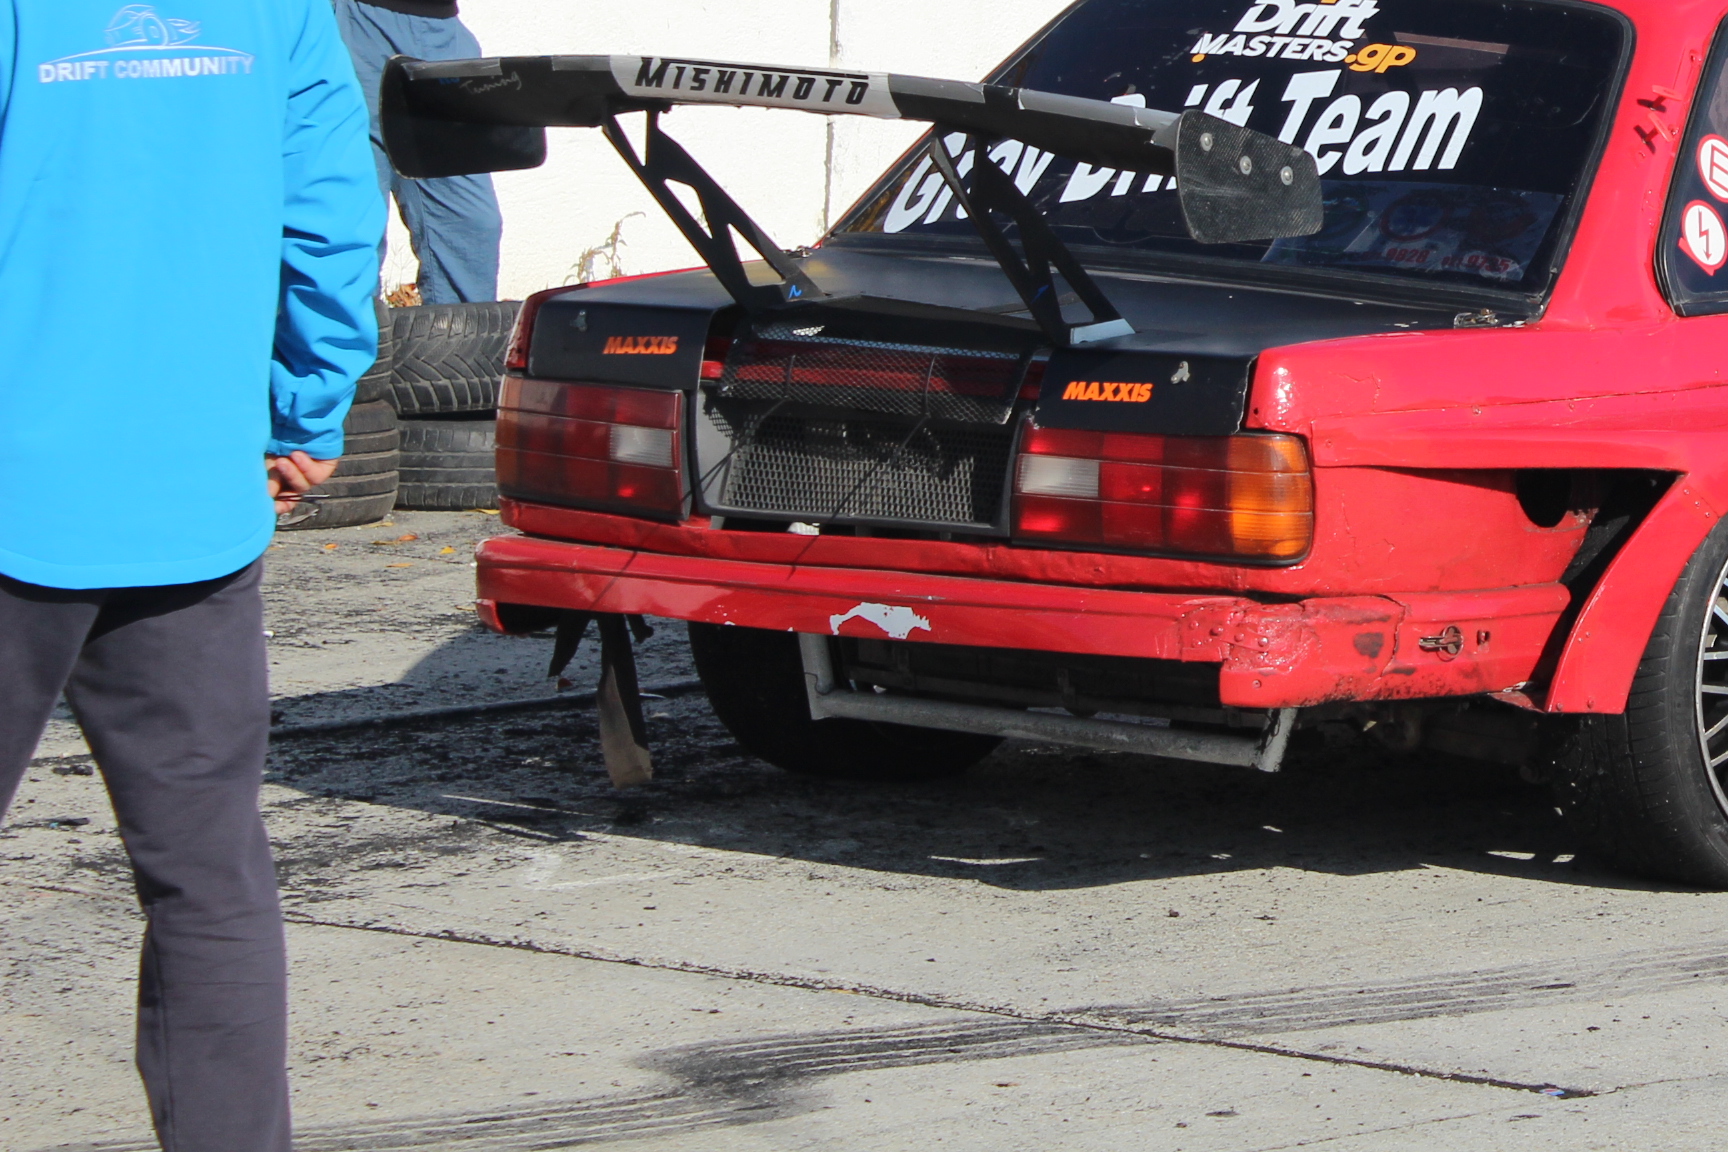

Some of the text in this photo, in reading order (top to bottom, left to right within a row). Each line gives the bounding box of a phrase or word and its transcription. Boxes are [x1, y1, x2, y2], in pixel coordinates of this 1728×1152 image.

[39, 56, 254, 83] DRIFT COMMUNITY
[635, 57, 868, 105] MISHIMOTO
[1278, 69, 1484, 177] Team
[603, 336, 679, 354] MAXXIS
[1062, 381, 1153, 402] MAXXIS
